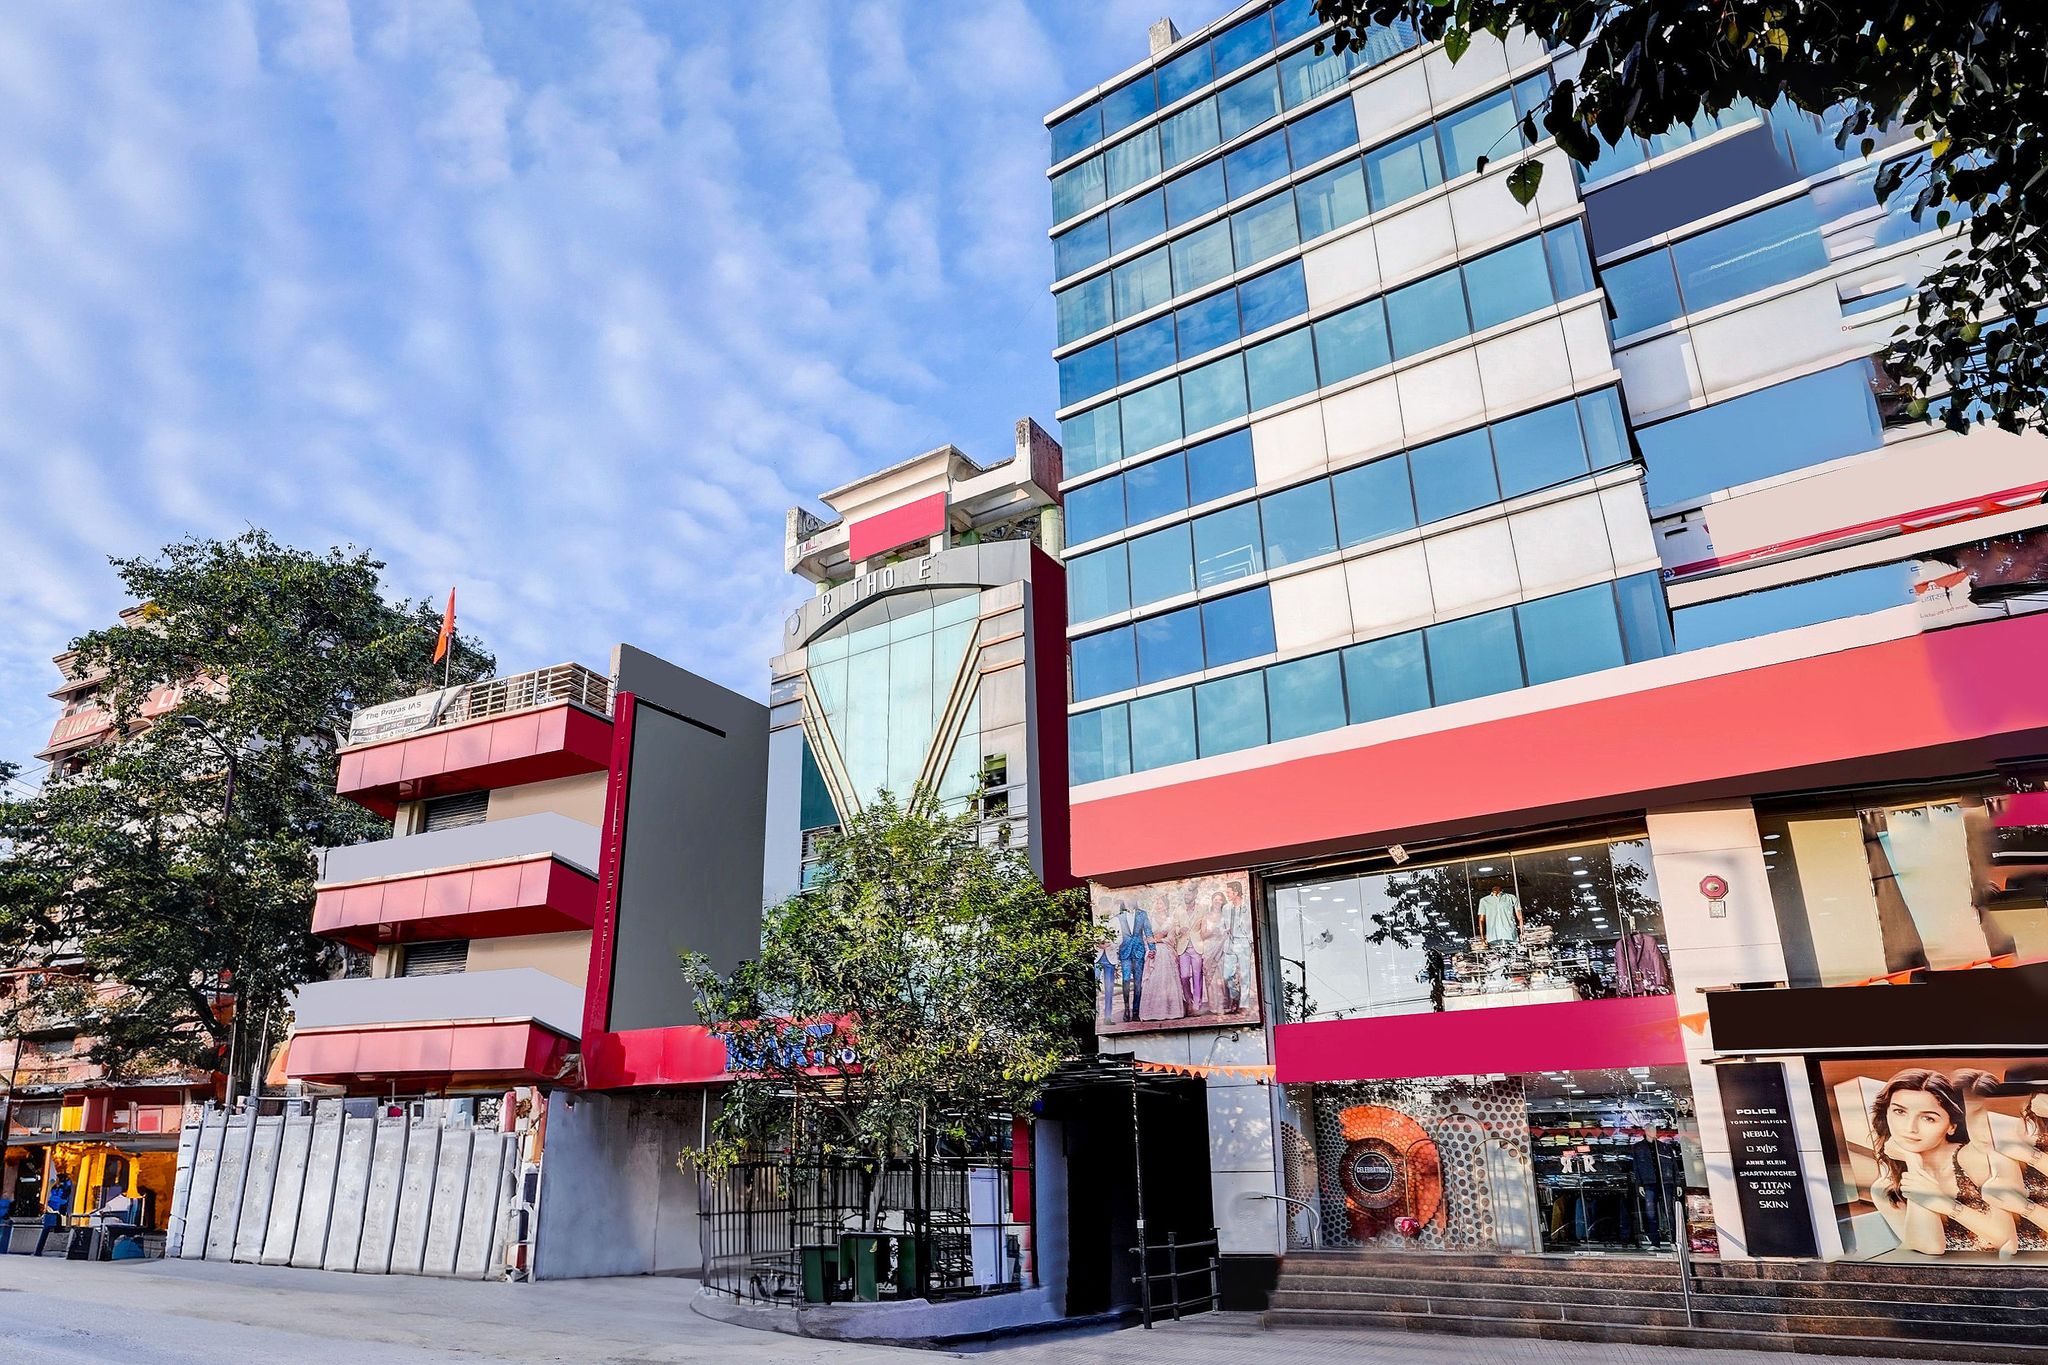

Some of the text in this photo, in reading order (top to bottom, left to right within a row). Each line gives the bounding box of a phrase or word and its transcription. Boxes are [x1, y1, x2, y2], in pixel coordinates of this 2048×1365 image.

[365, 712, 379, 720] The
[380, 705, 406, 717] Prayas
[408, 701, 422, 711] IAS
[1742, 1130, 1779, 1139] NEBULA
[1760, 1181, 1792, 1190] TITAN
